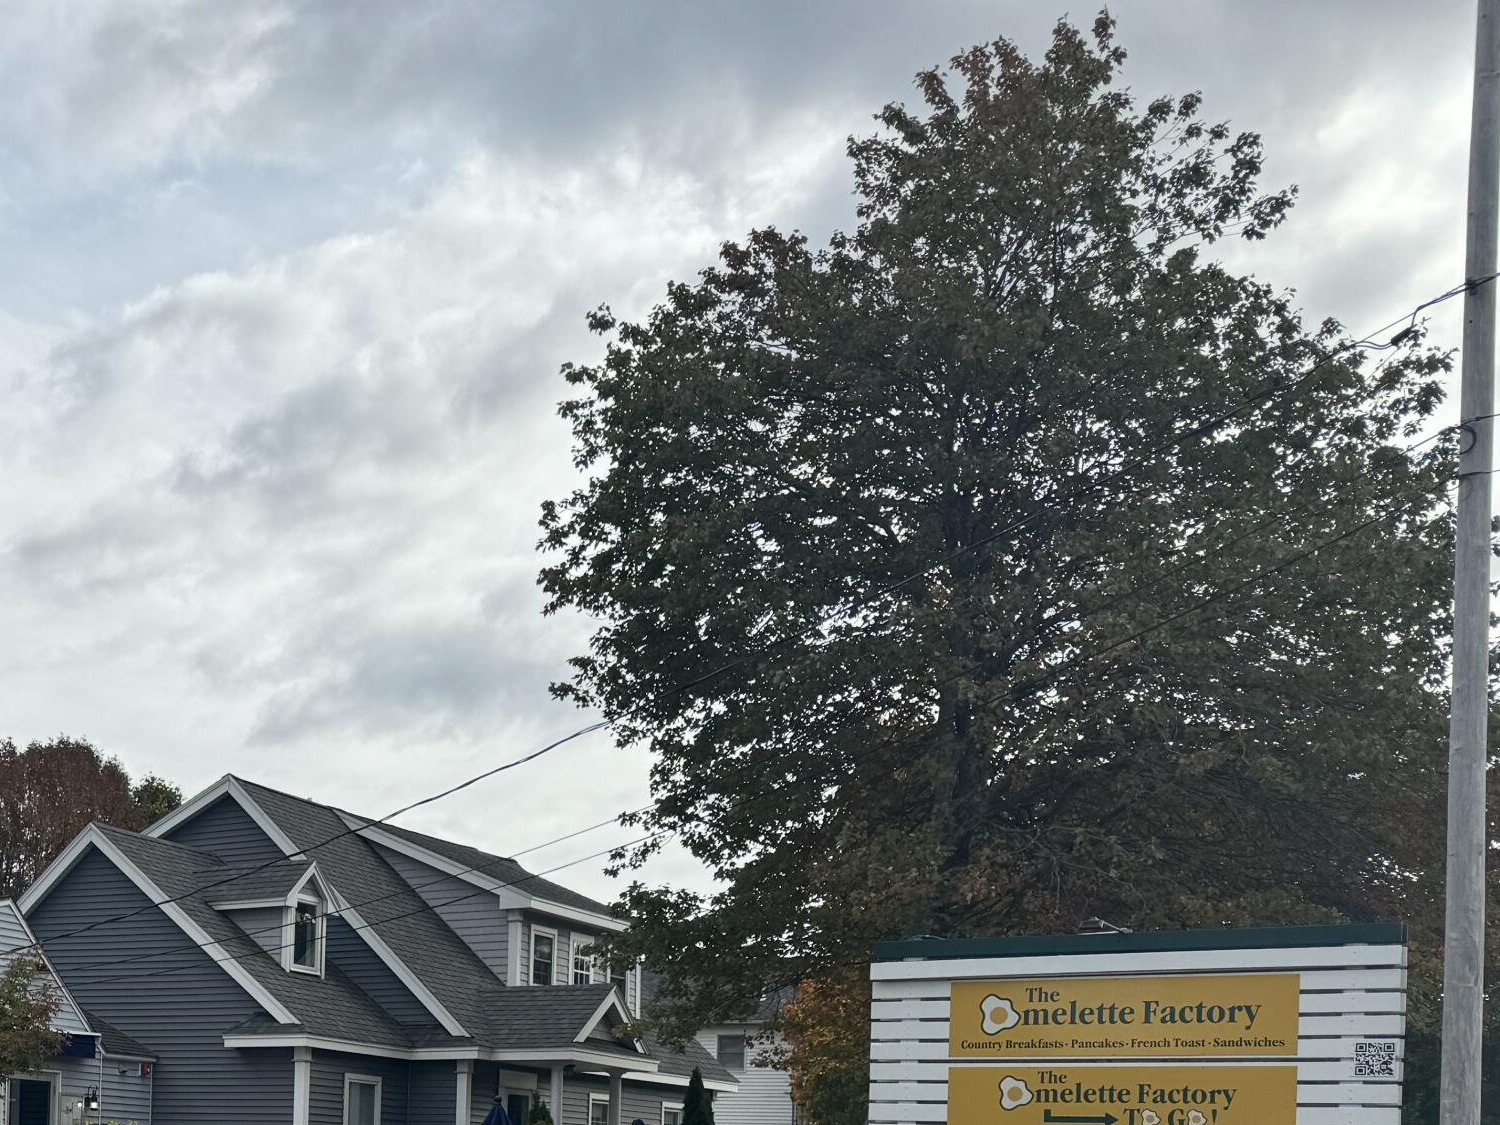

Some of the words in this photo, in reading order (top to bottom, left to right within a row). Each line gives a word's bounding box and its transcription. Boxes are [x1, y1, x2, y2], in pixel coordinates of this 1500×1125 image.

[1025, 987, 1060, 1003] The
[1142, 1000, 1262, 1030] Factory
[961, 1040, 1001, 1051] Country
[1005, 1038, 1064, 1049] Breakfasts
[1071, 1038, 1125, 1049] Pancakes
[1131, 1038, 1171, 1048] French
[1173, 1038, 1205, 1048] Toast
[1213, 1037, 1285, 1048] Sandwiches
[1037, 1071, 1068, 1084] The
[1137, 1083, 1237, 1110] Factory
